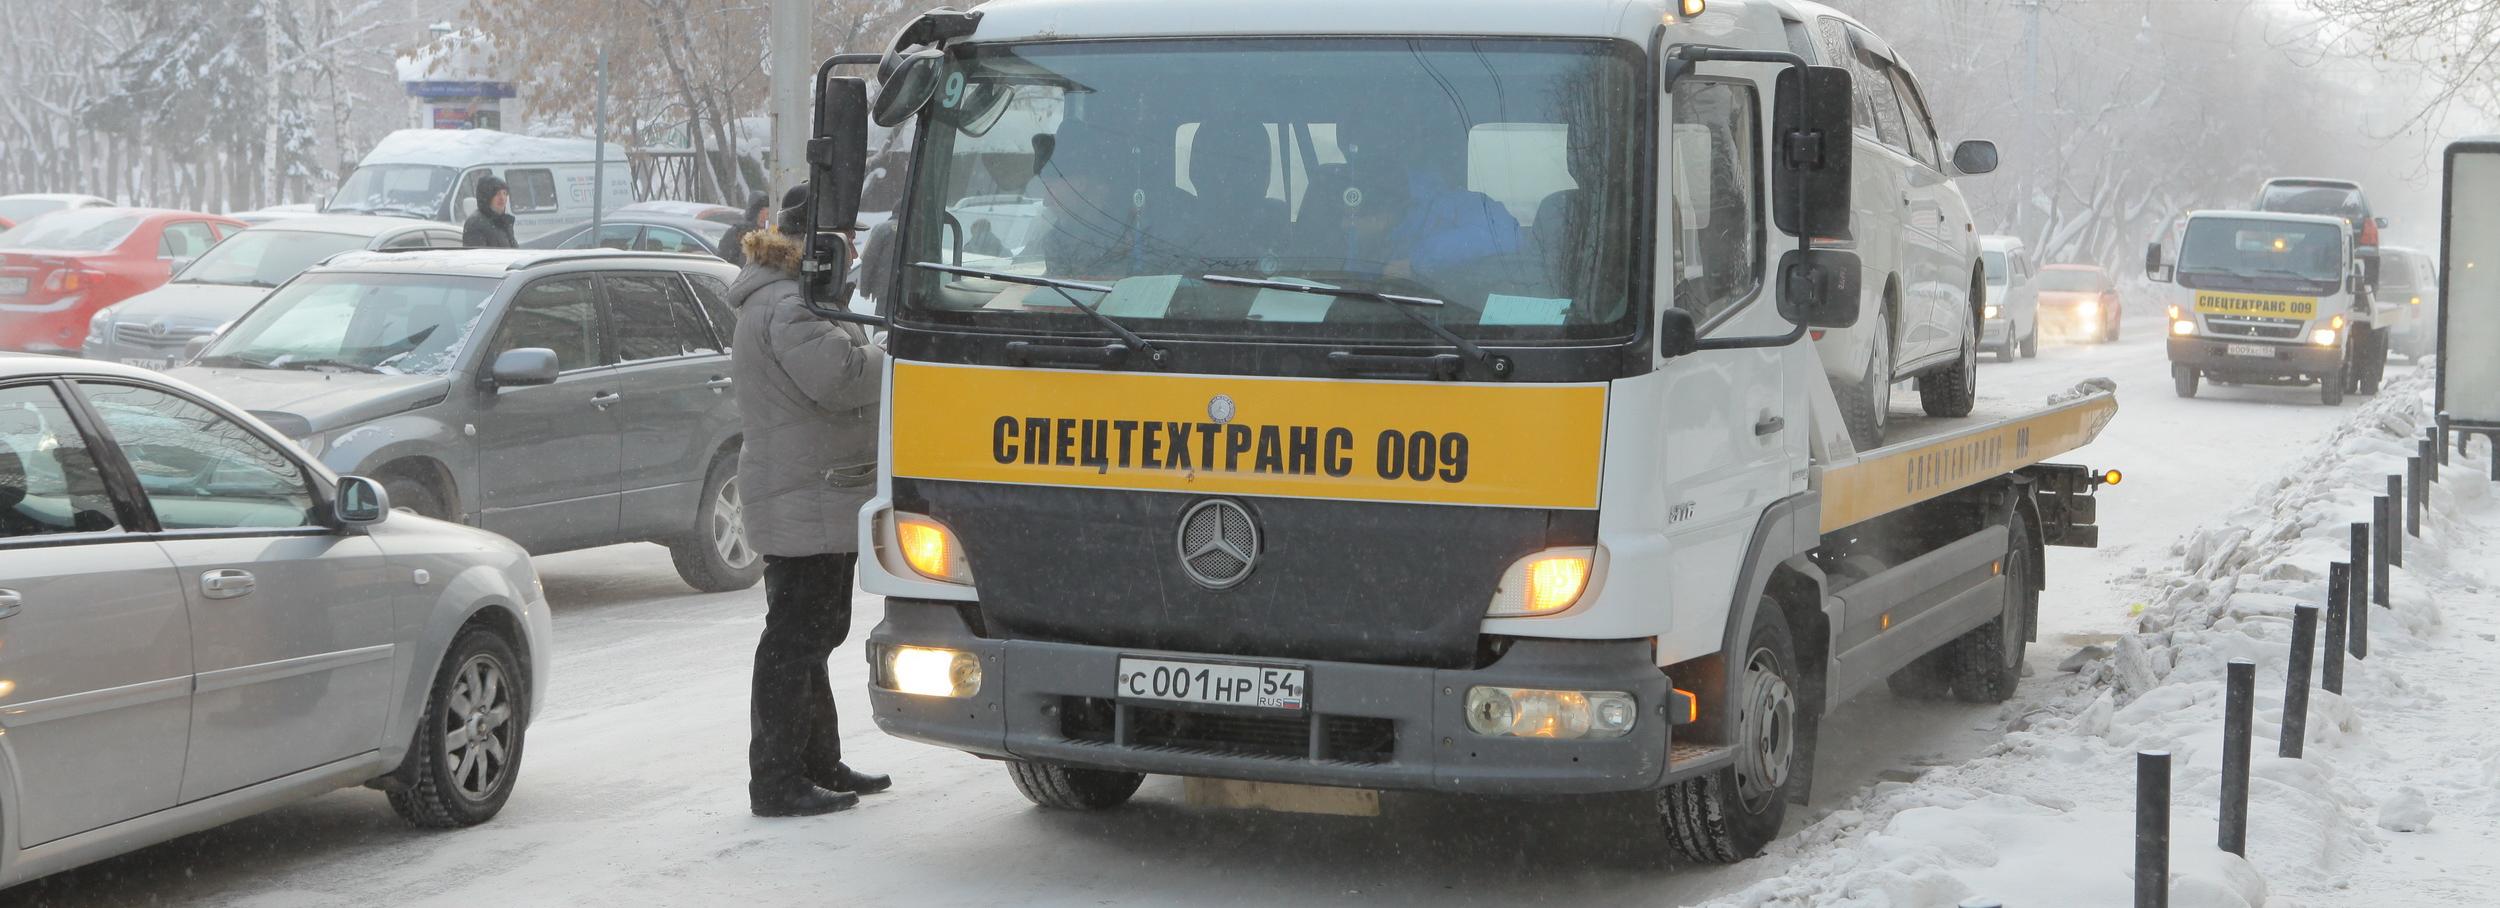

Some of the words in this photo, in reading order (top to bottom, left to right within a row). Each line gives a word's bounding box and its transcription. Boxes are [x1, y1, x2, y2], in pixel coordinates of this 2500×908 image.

[943, 71, 964, 109] 9
[2199, 295, 2286, 313] СПЕЦТЕХТРАНС
[2290, 302, 2312, 314] 009
[992, 415, 1354, 478] СПЕЦТЕХТРАНС
[1376, 429, 1469, 484] 009
[1907, 434, 2002, 495] СПЕЦТЕХТРАНС
[2016, 426, 2030, 459] 009
[1129, 665, 1253, 703] С001НР
[1263, 670, 1294, 697] 54
[1259, 696, 1281, 707] RUS
